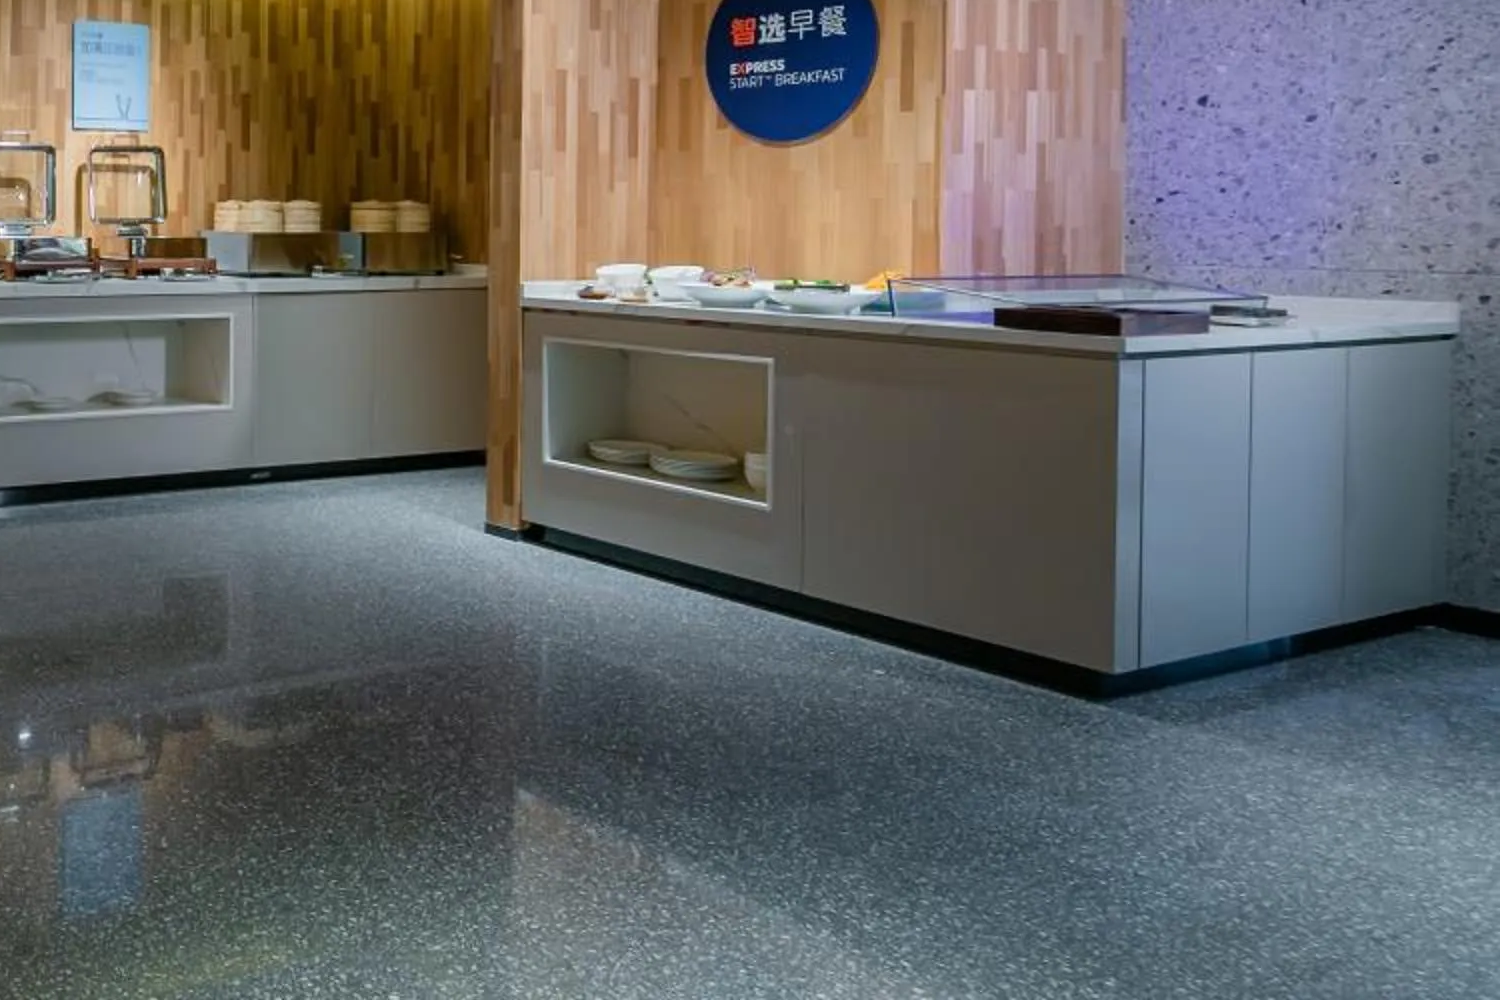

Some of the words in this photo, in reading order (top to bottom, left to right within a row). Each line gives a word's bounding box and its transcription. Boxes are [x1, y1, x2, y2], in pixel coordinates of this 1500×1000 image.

[730, 4, 847, 47] 智选早餐
[729, 59, 786, 75] EXPRESS
[774, 68, 846, 87] BREAKFAST
